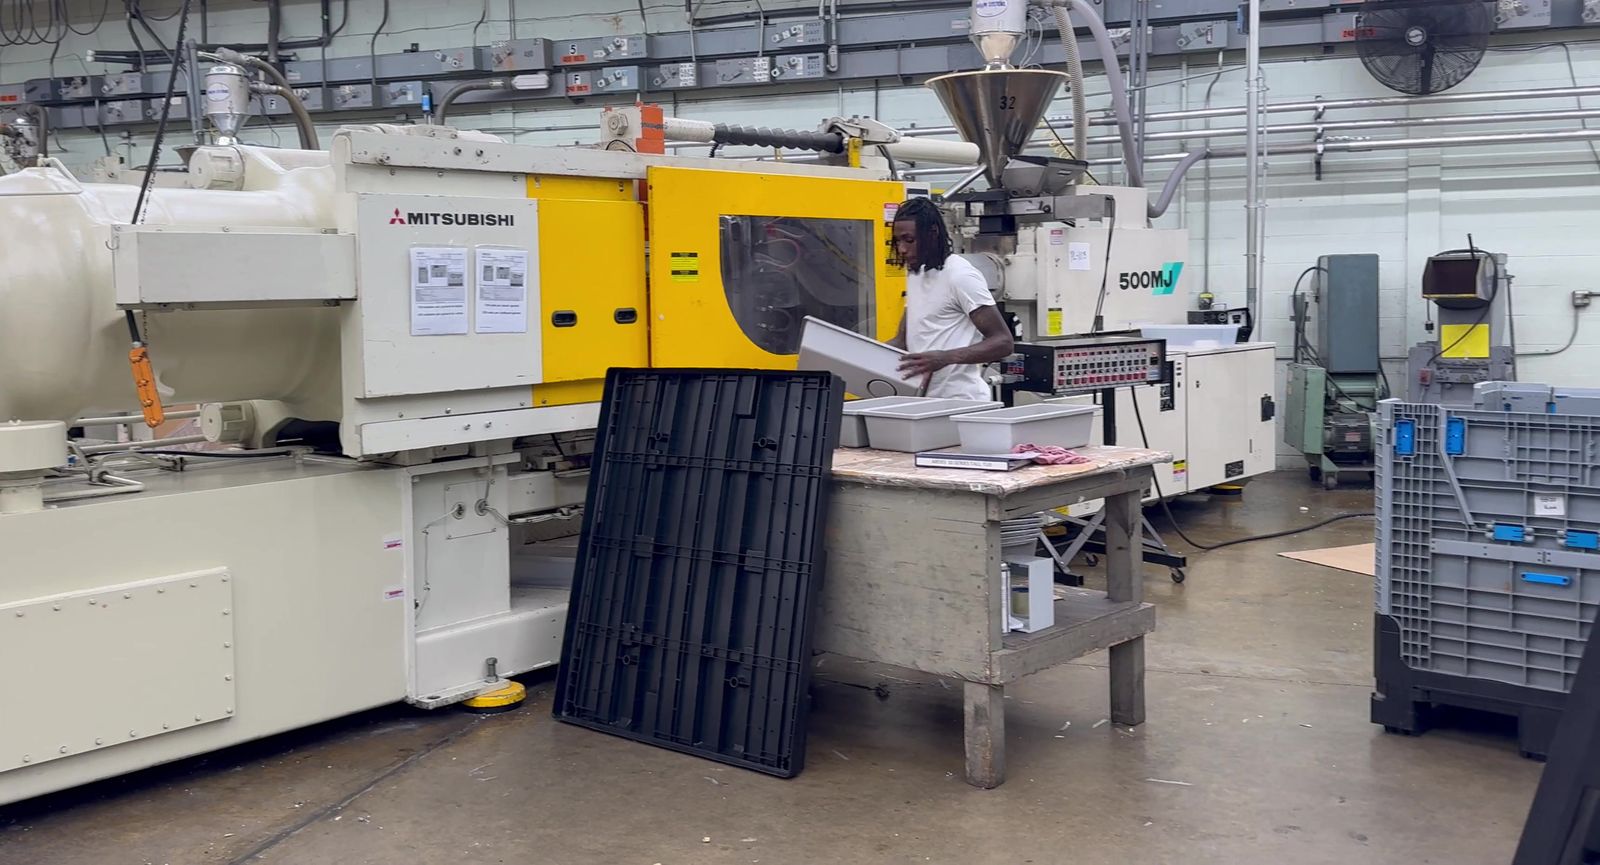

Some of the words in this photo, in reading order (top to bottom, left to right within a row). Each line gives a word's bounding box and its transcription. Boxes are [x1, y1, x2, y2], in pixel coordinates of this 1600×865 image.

[570, 44, 577, 55] 5
[1000, 95, 1016, 110] 32
[407, 212, 514, 227] MITSUBISHI
[1119, 270, 1173, 290] 500MJ
